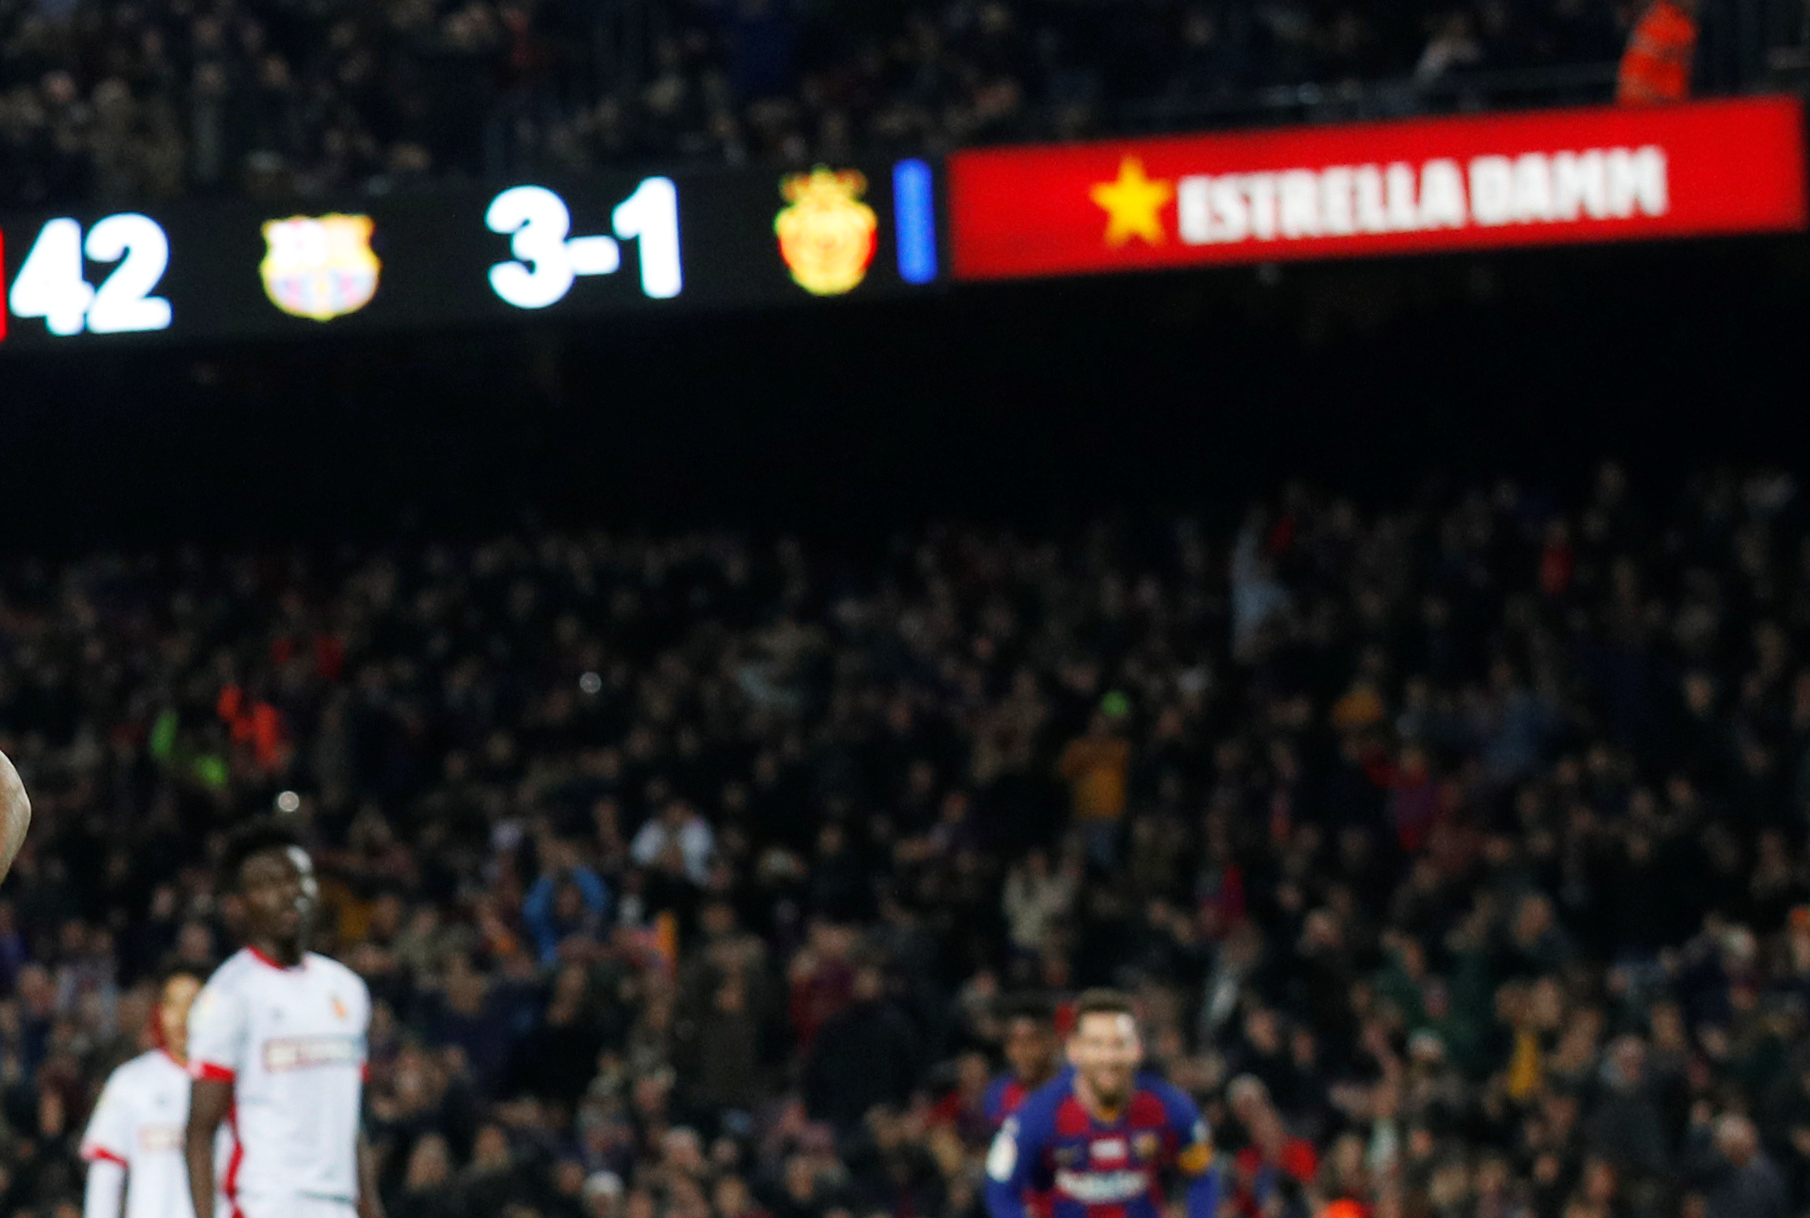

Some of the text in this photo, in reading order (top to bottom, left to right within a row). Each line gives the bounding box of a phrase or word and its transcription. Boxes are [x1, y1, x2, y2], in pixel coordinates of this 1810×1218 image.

[485, 176, 683, 309] 3-1
[1178, 145, 1669, 246] ESTRELLA DAMM
[10, 212, 172, 336] 42
